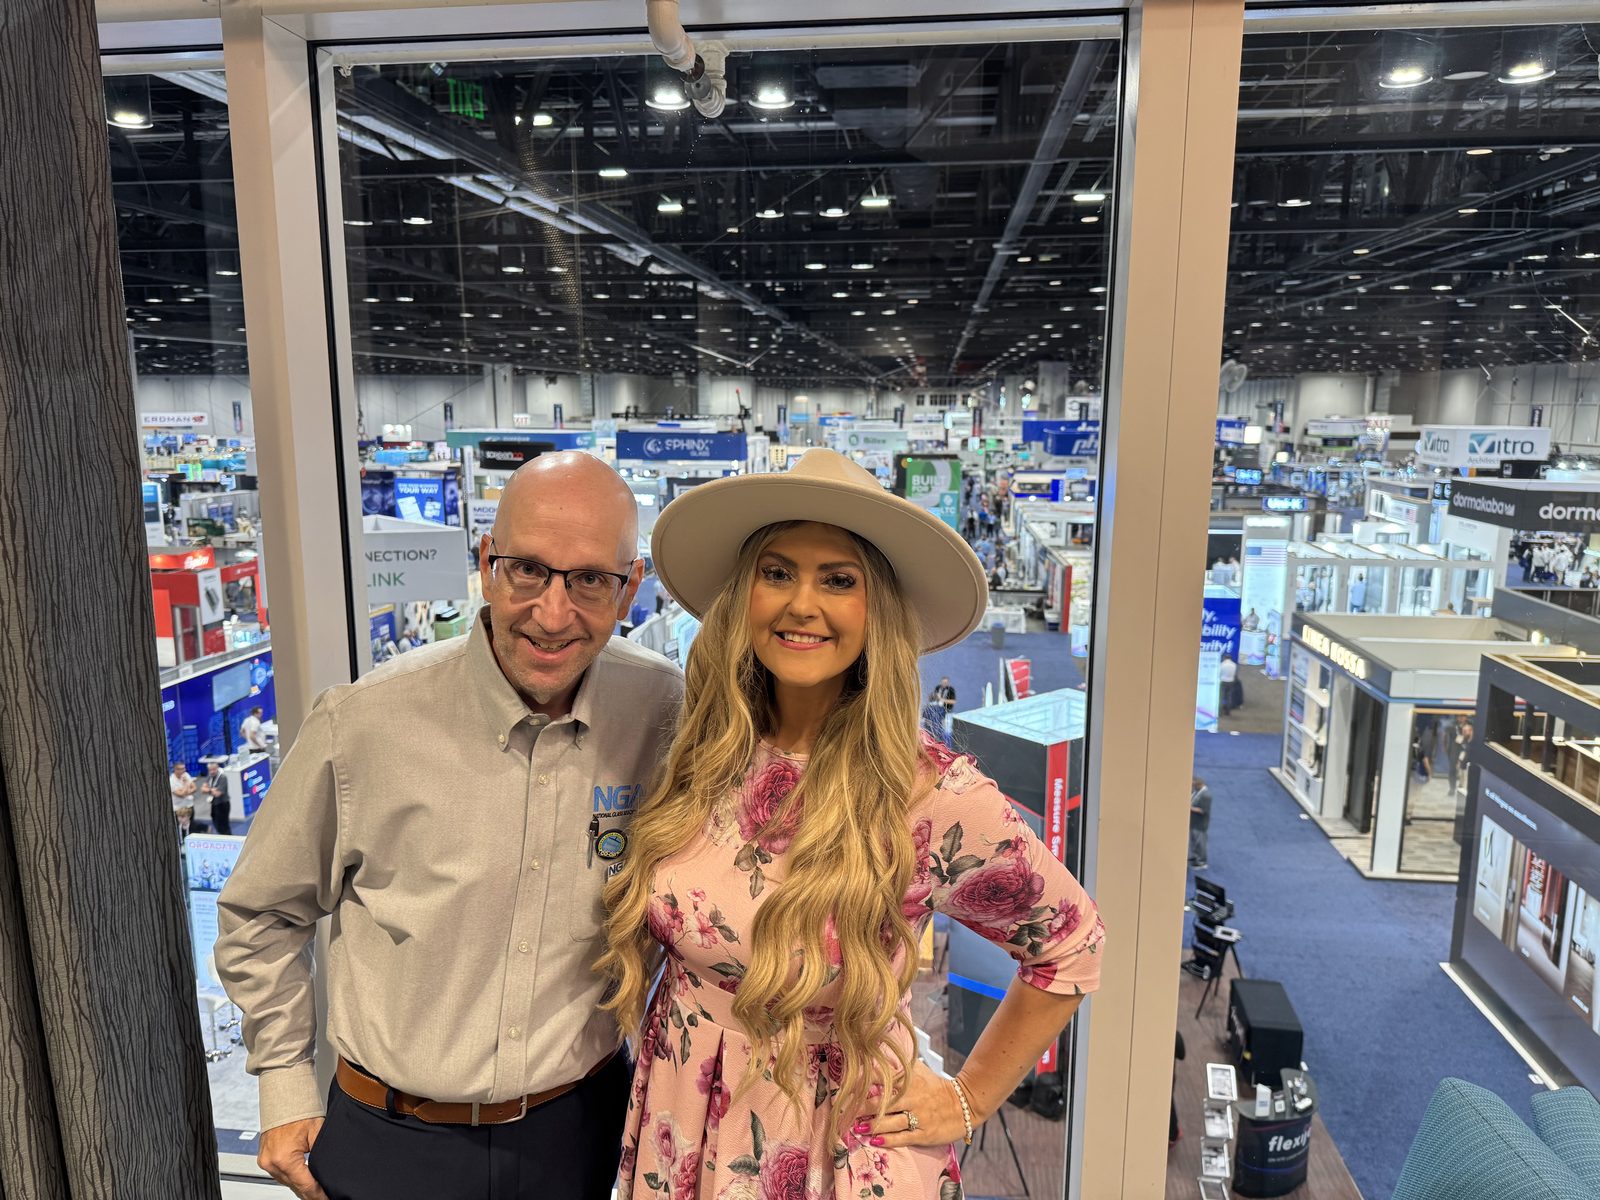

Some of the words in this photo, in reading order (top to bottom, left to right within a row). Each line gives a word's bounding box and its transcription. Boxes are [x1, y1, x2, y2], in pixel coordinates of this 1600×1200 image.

[664, 438, 709, 451] SPHINX
[1468, 433, 1535, 455] Vitro
[1453, 491, 1505, 516] dormakaba
[1539, 502, 1600, 521] dorm
[367, 572, 406, 588] INK
[608, 862, 623, 876] NG
